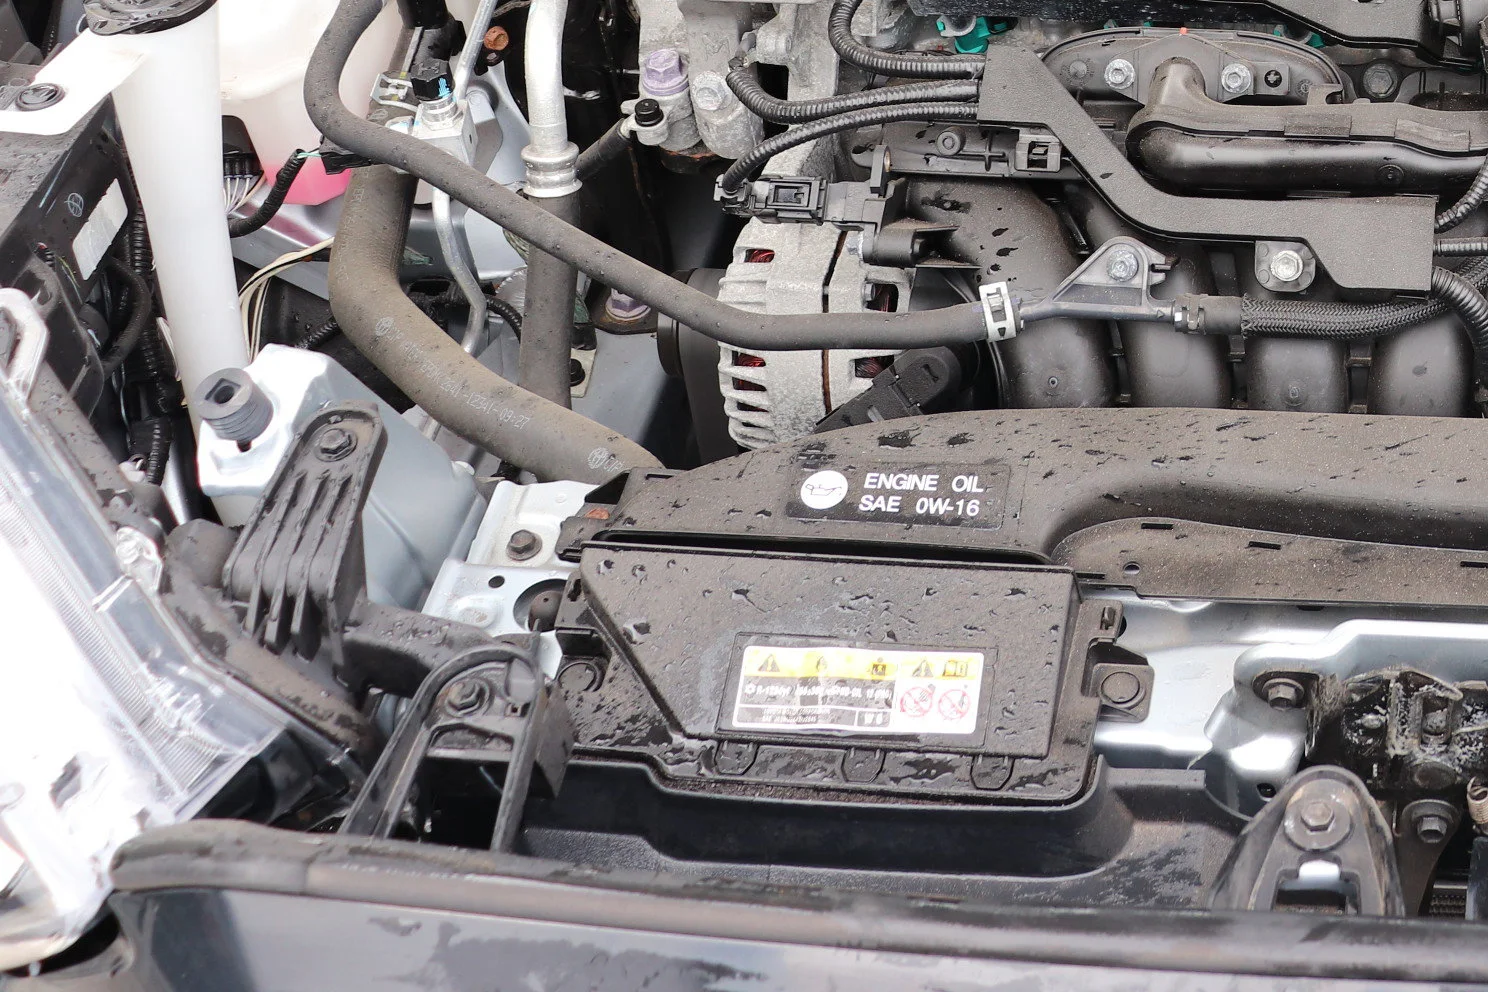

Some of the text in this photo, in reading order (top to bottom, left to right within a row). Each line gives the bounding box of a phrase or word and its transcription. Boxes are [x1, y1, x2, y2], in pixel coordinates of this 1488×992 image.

[864, 473, 984, 493] ENGINE OIL
[859, 495, 980, 517] SAE 0W-16
